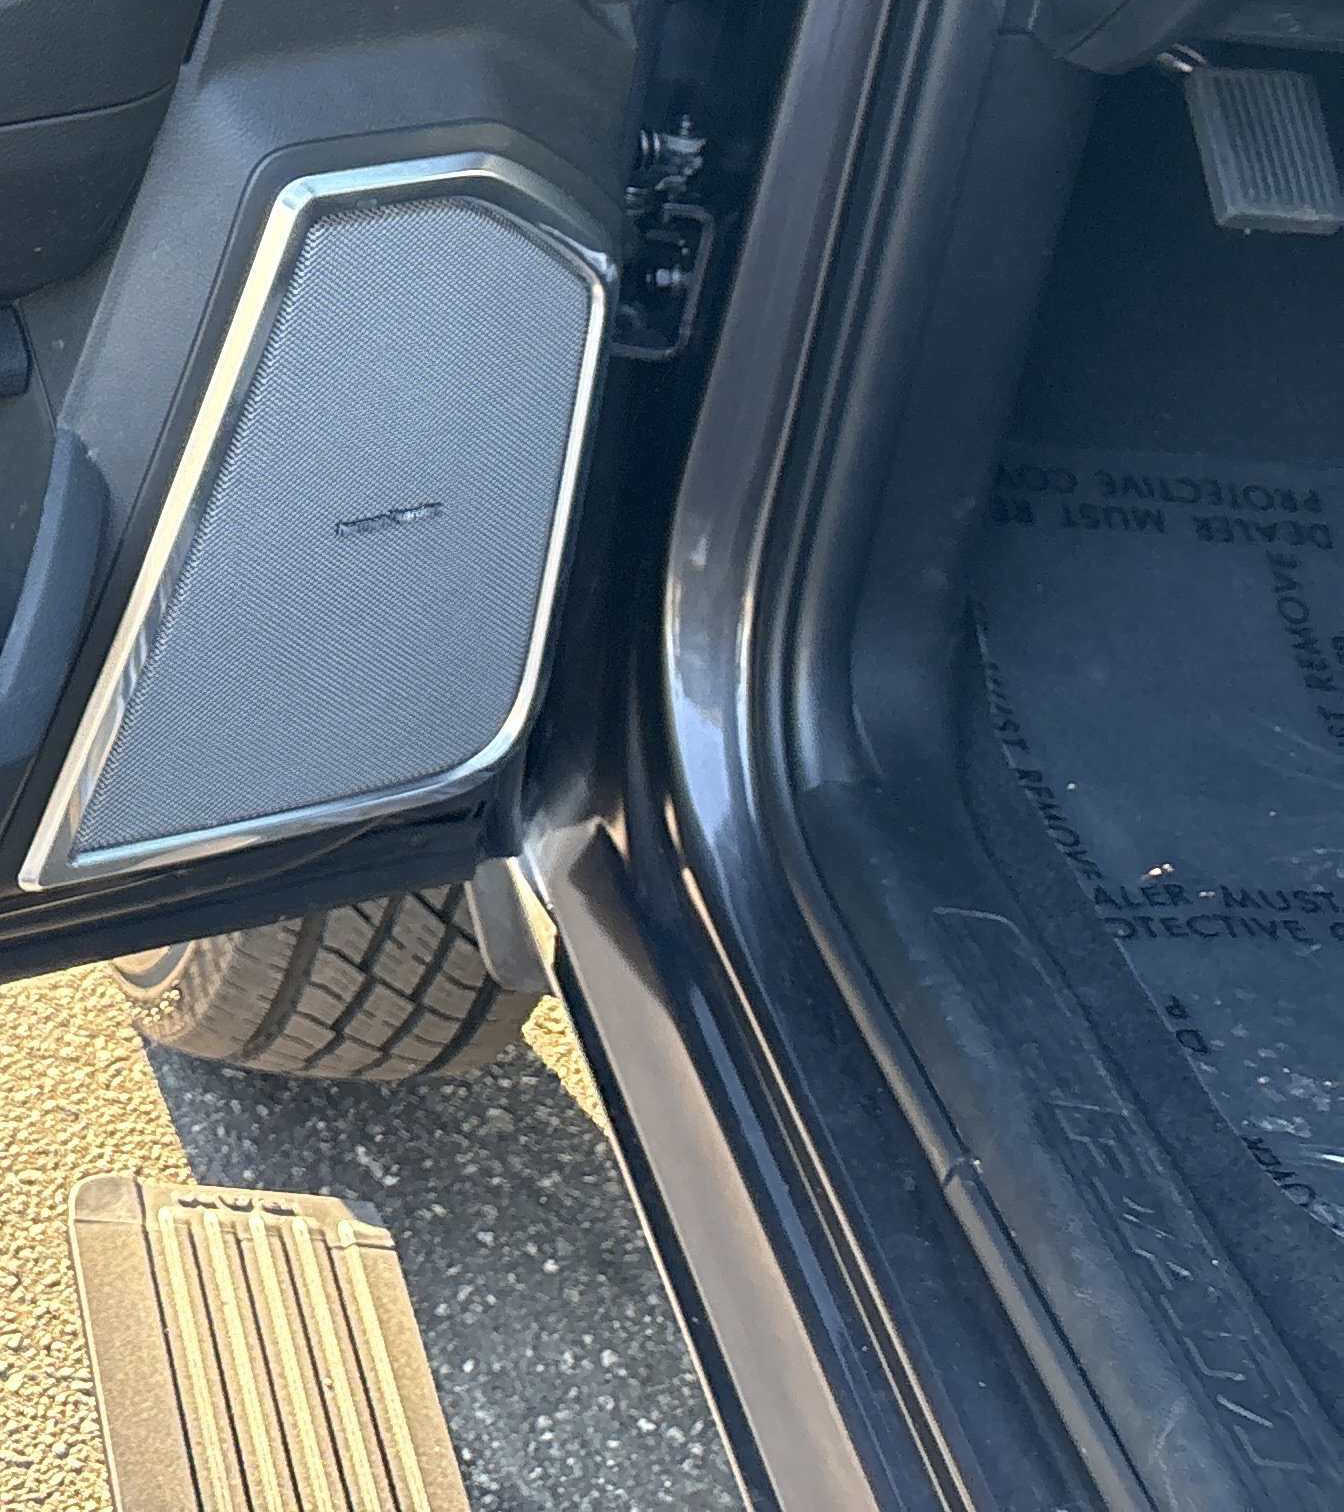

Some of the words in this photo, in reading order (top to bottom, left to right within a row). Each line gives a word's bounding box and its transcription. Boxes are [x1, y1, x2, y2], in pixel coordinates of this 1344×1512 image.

[1094, 467, 1325, 515] PROTECTIVE
[1062, 501, 1166, 535] MUST
[1219, 883, 1340, 913] MUST
